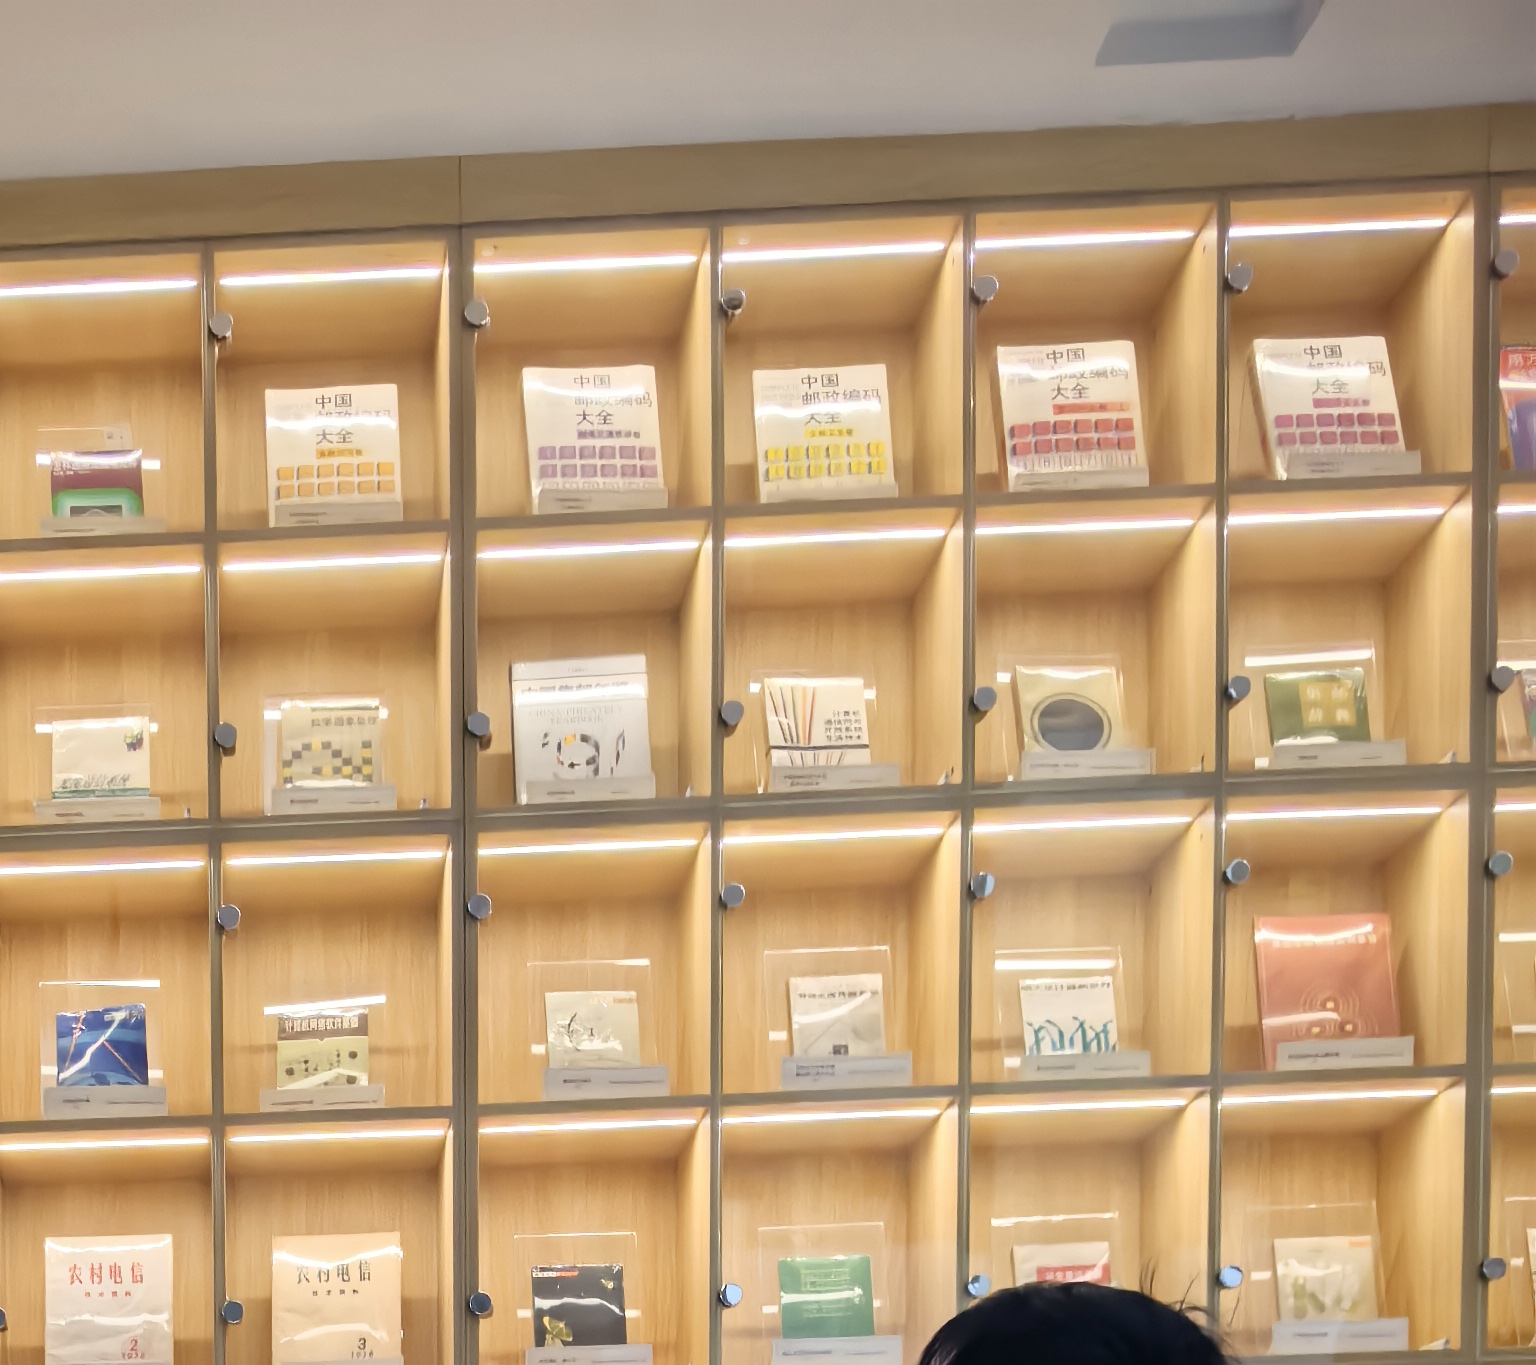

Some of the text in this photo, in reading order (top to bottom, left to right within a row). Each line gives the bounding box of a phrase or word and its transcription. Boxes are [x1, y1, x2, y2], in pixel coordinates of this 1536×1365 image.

[1045, 347, 1086, 364] 中国
[1304, 344, 1343, 360] 中国
[573, 374, 611, 389] 中国
[801, 373, 840, 390] 中国
[315, 393, 353, 410] 中国
[575, 409, 614, 427] 大全
[315, 427, 354, 446] 大全
[68, 1261, 145, 1286] 农村电信
[295, 1259, 371, 1285] 农村电信
[129, 1338, 139, 1353] 2
[357, 1337, 367, 1351] 3
